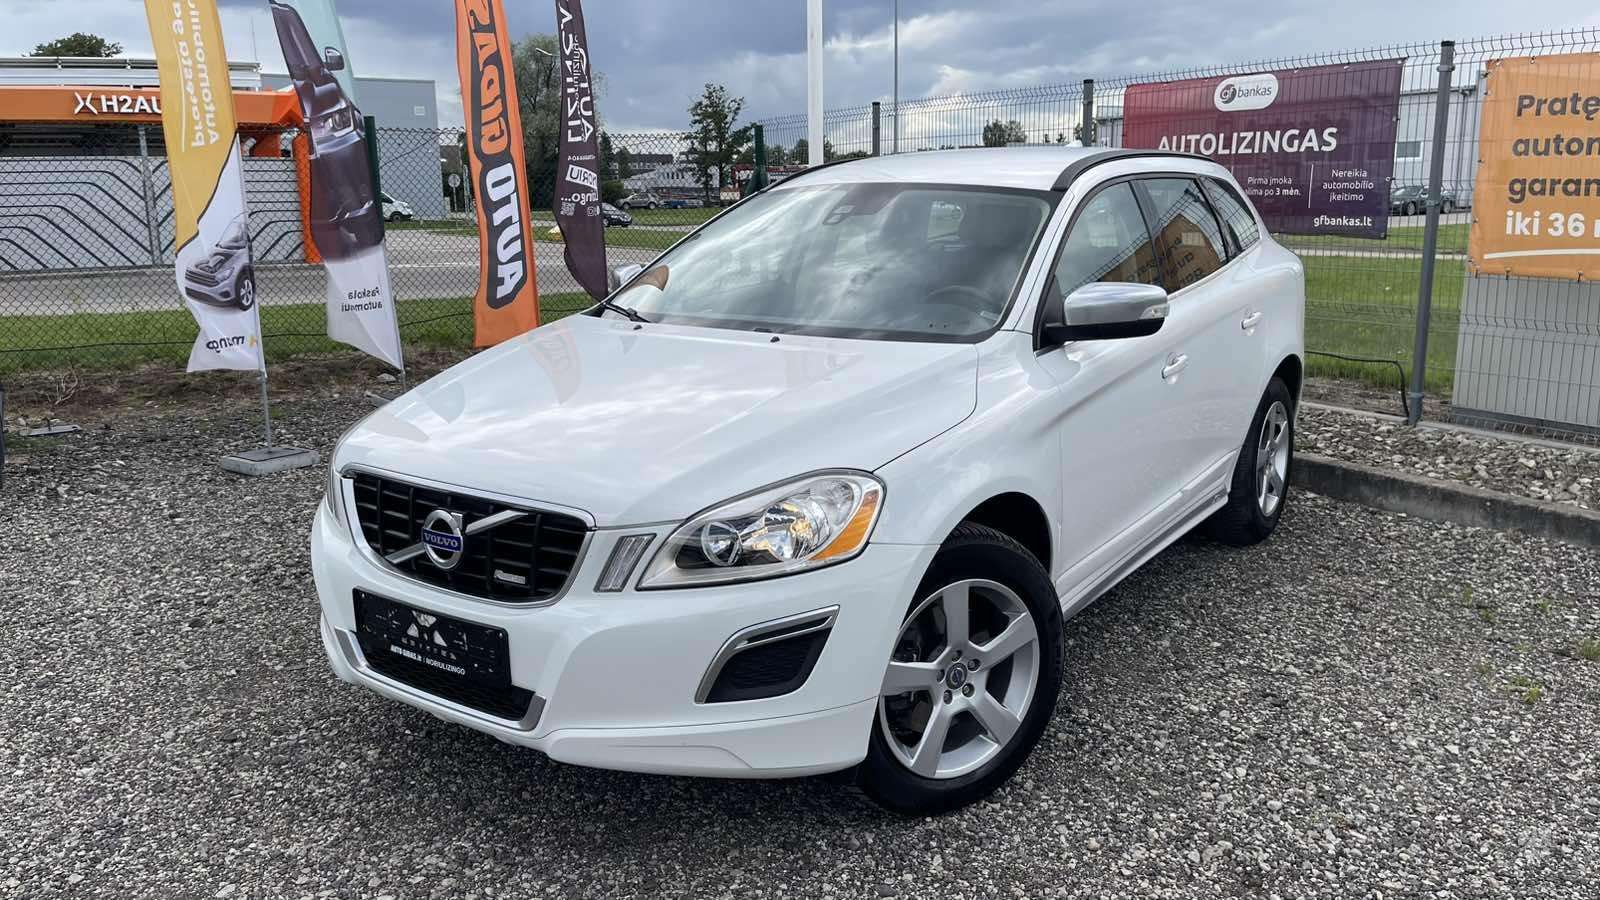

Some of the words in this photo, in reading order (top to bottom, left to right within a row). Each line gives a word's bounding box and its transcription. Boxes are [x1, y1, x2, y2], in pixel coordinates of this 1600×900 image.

[1237, 85, 1272, 98] bankas
[1516, 92, 1600, 121] Pratę
[1158, 127, 1337, 155] AUTOLIZINGAS
[1332, 169, 1368, 178] Nereikia
[1247, 176, 1268, 185] Pirma
[1322, 180, 1374, 190] automobilio
[1264, 188, 1274, 197] po
[1275, 187, 1281, 196] 3
[1508, 177, 1600, 204] garan
[1313, 215, 1372, 227] gfbankas.lt
[1505, 210, 1541, 236] iki
[1547, 213, 1586, 238] 36
[423, 532, 458, 547] VOLVO
